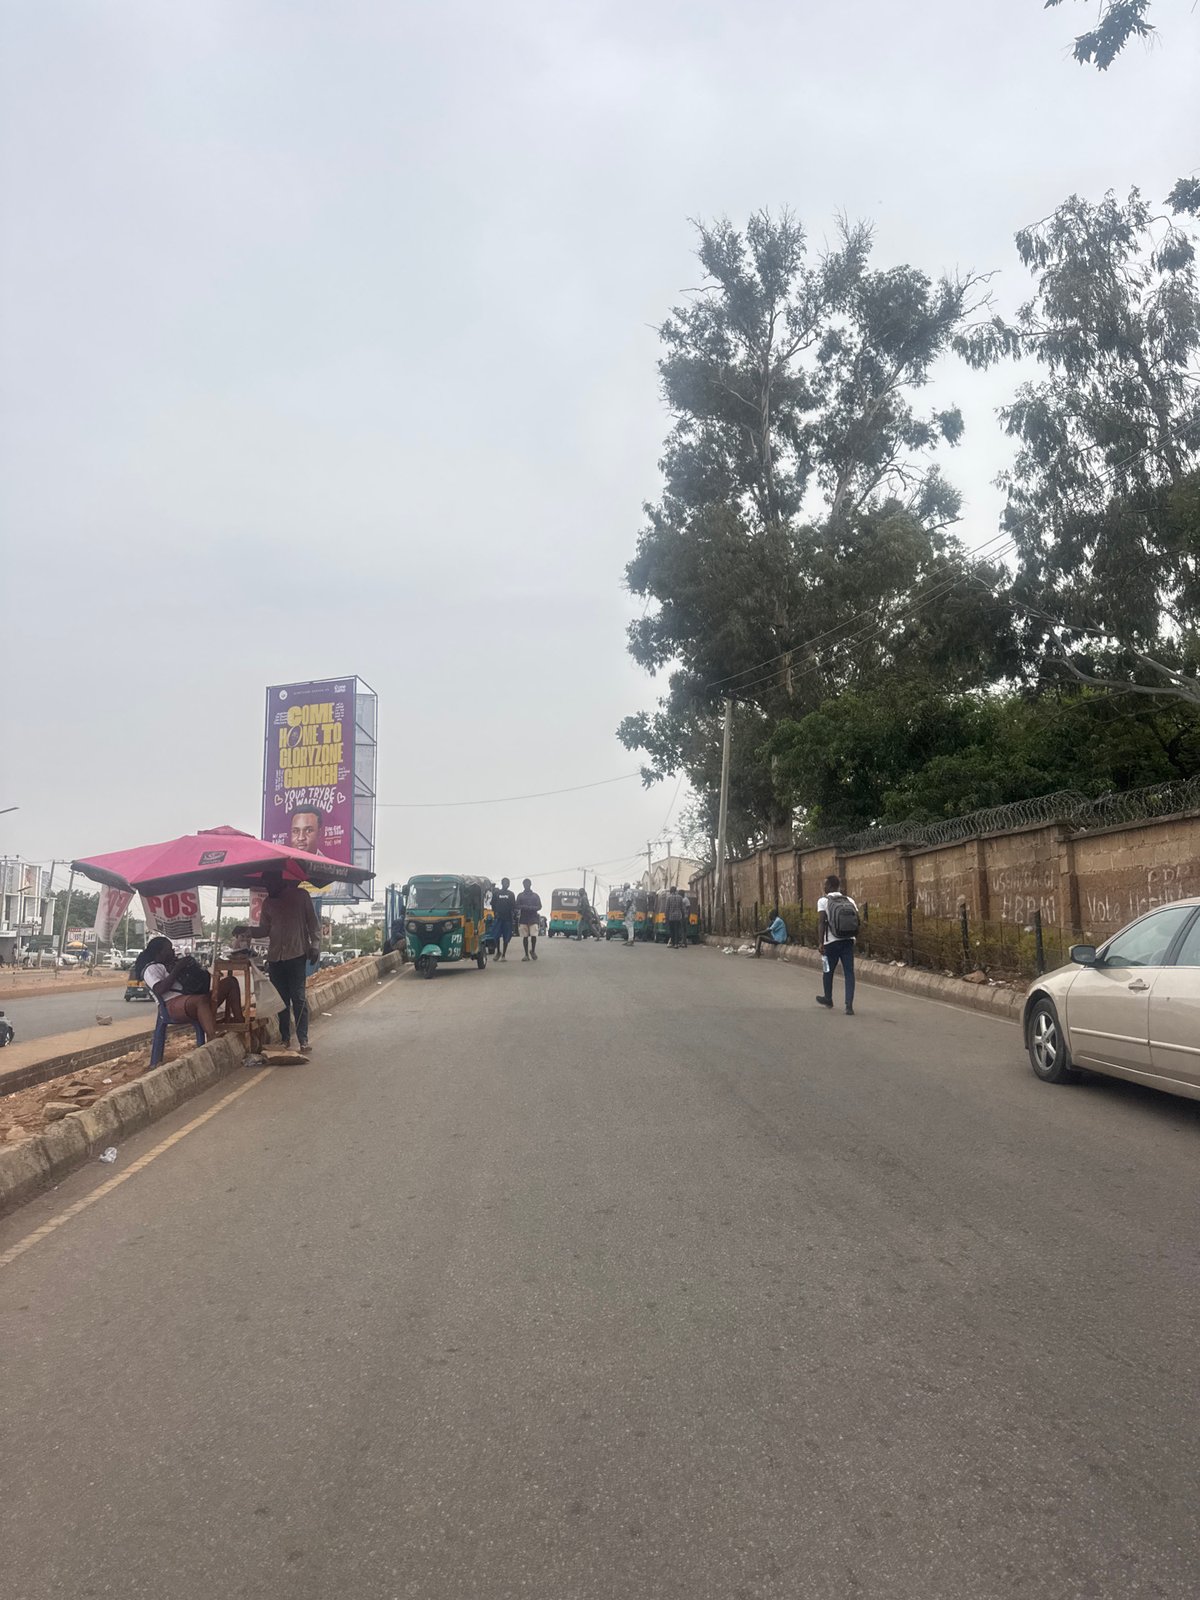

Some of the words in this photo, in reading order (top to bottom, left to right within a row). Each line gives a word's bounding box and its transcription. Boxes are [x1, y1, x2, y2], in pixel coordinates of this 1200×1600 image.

[287, 702, 335, 727] COME
[279, 724, 319, 749] HOME
[322, 722, 342, 744] TO
[279, 742, 344, 768] GLORYZONE
[283, 764, 338, 789] CHURCH
[284, 788, 306, 803] YOUR
[308, 787, 337, 802] TRYBE
[285, 799, 293, 814] IS
[296, 798, 334, 813] WAITING
[146, 891, 198, 919] POS
[1086, 889, 1121, 921] Vote
